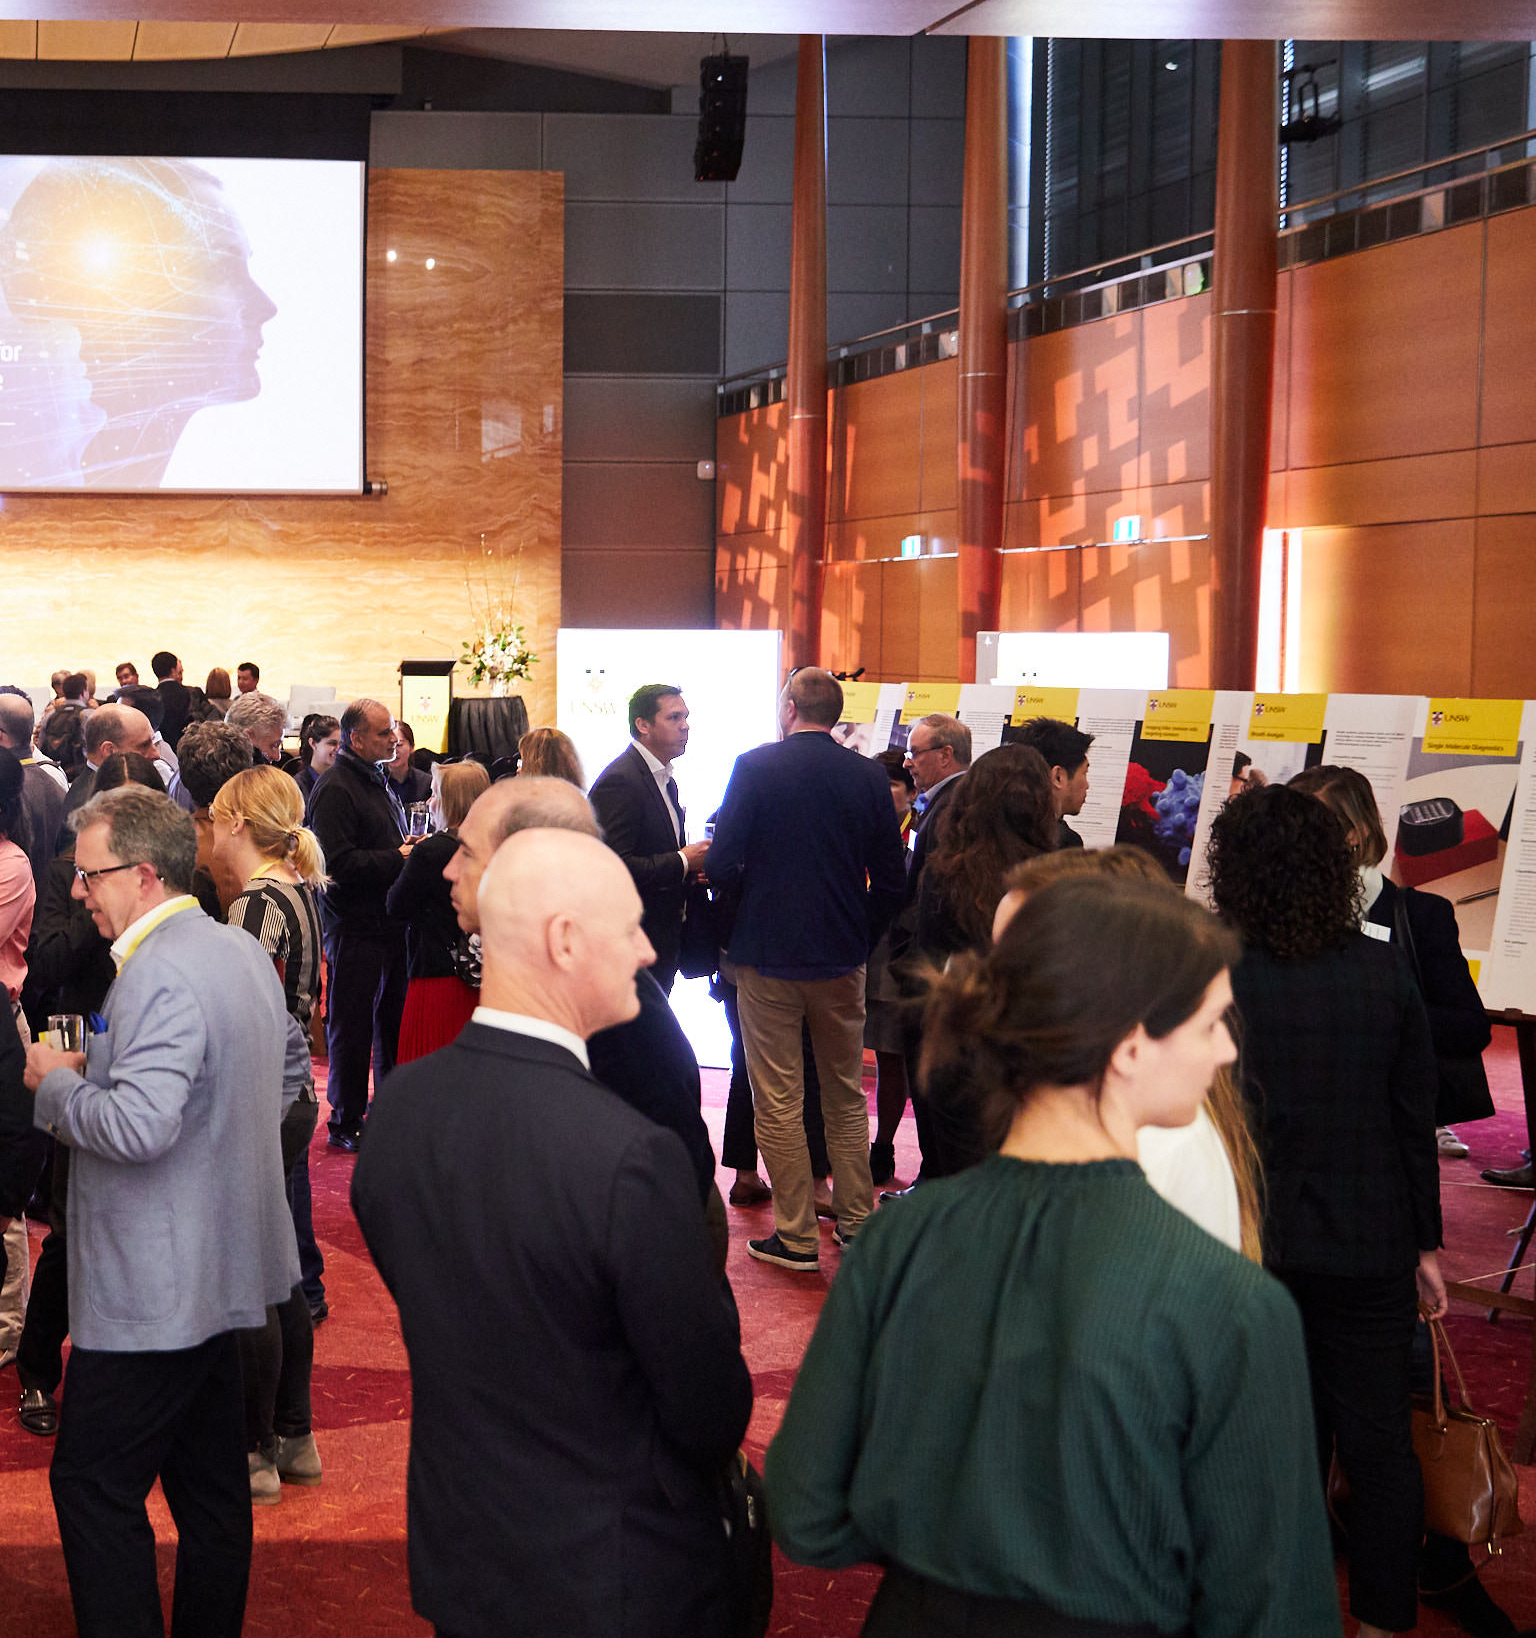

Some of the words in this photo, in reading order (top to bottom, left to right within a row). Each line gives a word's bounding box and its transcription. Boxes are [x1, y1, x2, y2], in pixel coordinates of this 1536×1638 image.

[1158, 701, 1178, 709] UNSW
[1265, 706, 1286, 714] UNSW
[1444, 714, 1471, 723] UNSW
[1427, 741, 1444, 750] Single
[1445, 742, 1471, 751] Molecule
[1471, 743, 1504, 752] Diagnostics
